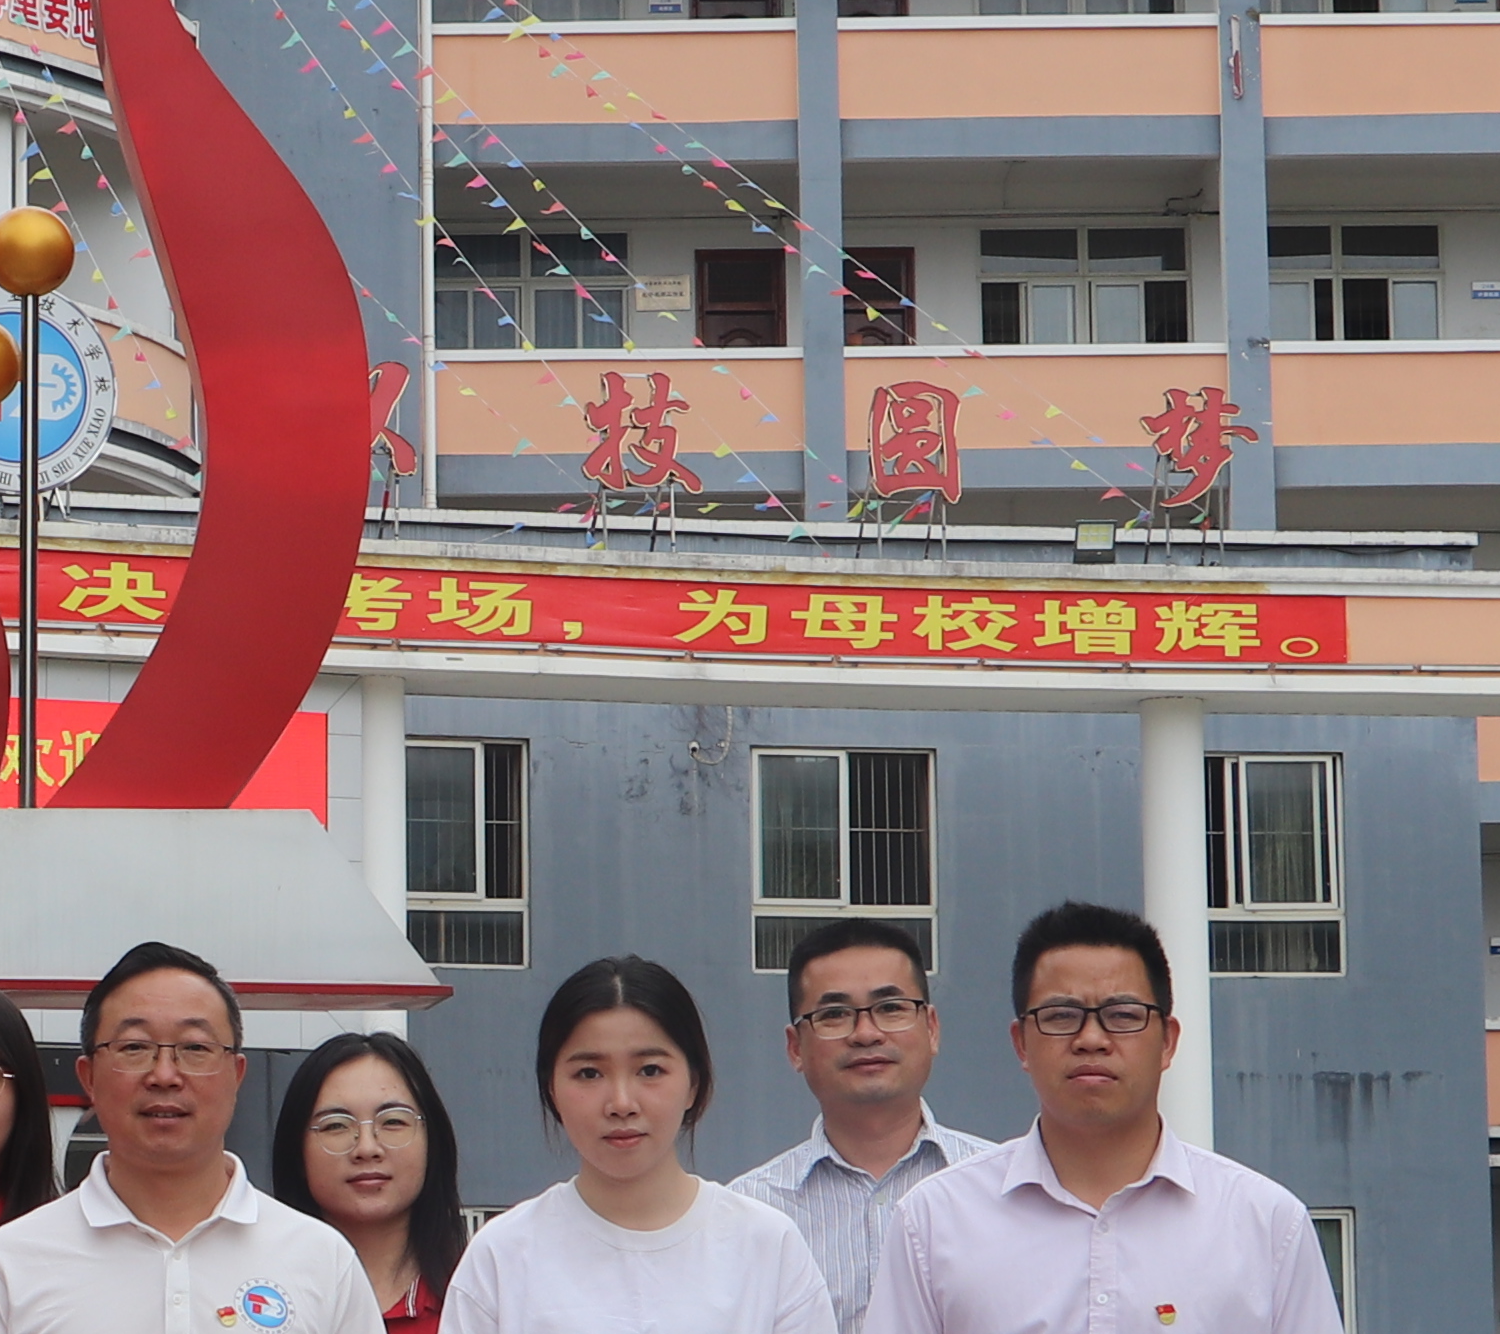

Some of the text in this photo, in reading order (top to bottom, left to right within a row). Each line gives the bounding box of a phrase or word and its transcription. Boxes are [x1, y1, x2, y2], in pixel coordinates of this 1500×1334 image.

[51, 456, 75, 478] SHU
[72, 437, 95, 462] XUE
[86, 408, 107, 439] XIAO
